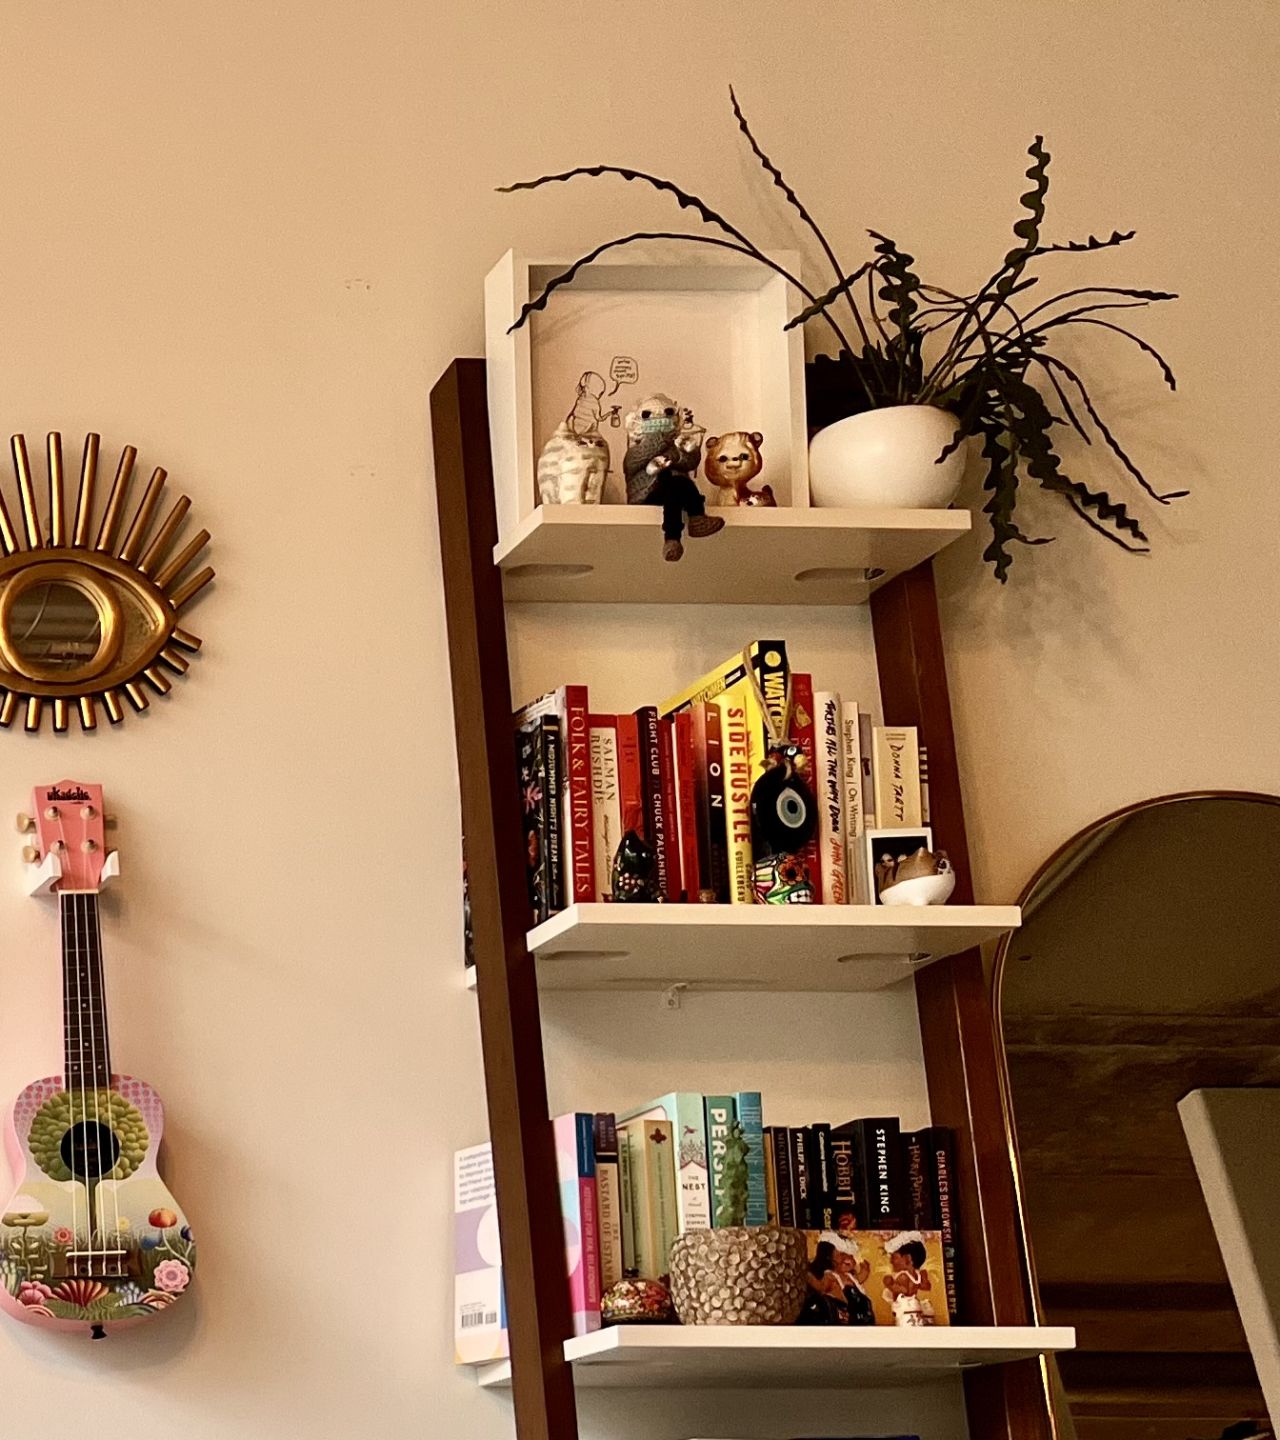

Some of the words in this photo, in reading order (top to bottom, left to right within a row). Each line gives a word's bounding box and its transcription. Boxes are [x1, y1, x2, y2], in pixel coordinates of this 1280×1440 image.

[570, 707, 585, 754] FOLK
[648, 711, 658, 743] FIGHT
[727, 707, 746, 757] SIDE
[825, 700, 835, 735] TURTLES
[827, 739, 838, 757] ALL
[844, 719, 856, 754] Stephen
[573, 758, 584, 770] &
[590, 734, 604, 805] RUSHDIE
[604, 738, 616, 801] SALMAN
[651, 748, 659, 775] CLUB
[828, 759, 838, 778] THE
[846, 757, 857, 778] King
[889, 743, 904, 779] DONNA
[572, 777, 589, 835] FAIRY
[730, 763, 751, 844] HUSTLE
[828, 780, 840, 804] WAY
[849, 788, 859, 802] On
[894, 784, 904, 822] TARTT
[654, 794, 663, 829] CHUCK
[830, 805, 841, 833] DOWN
[575, 837, 591, 892] TALES
[830, 837, 844, 866] JOHN
[796, 1133, 804, 1161] PHILIP
[876, 1129, 887, 1179] STEPHEN
[799, 1177, 807, 1199] DICK
[831, 1140, 855, 1205] HOBBIT
[936, 1150, 948, 1192] CHARLES
[600, 1169, 612, 1219] BASTARD
[879, 1185, 890, 1213] KING
[601, 1221, 613, 1238] OF
[823, 1208, 832, 1230] Scar
[940, 1195, 952, 1243] BUKOWSKI
[603, 1240, 615, 1289] ISTANB
[946, 1262, 955, 1281] HAM
